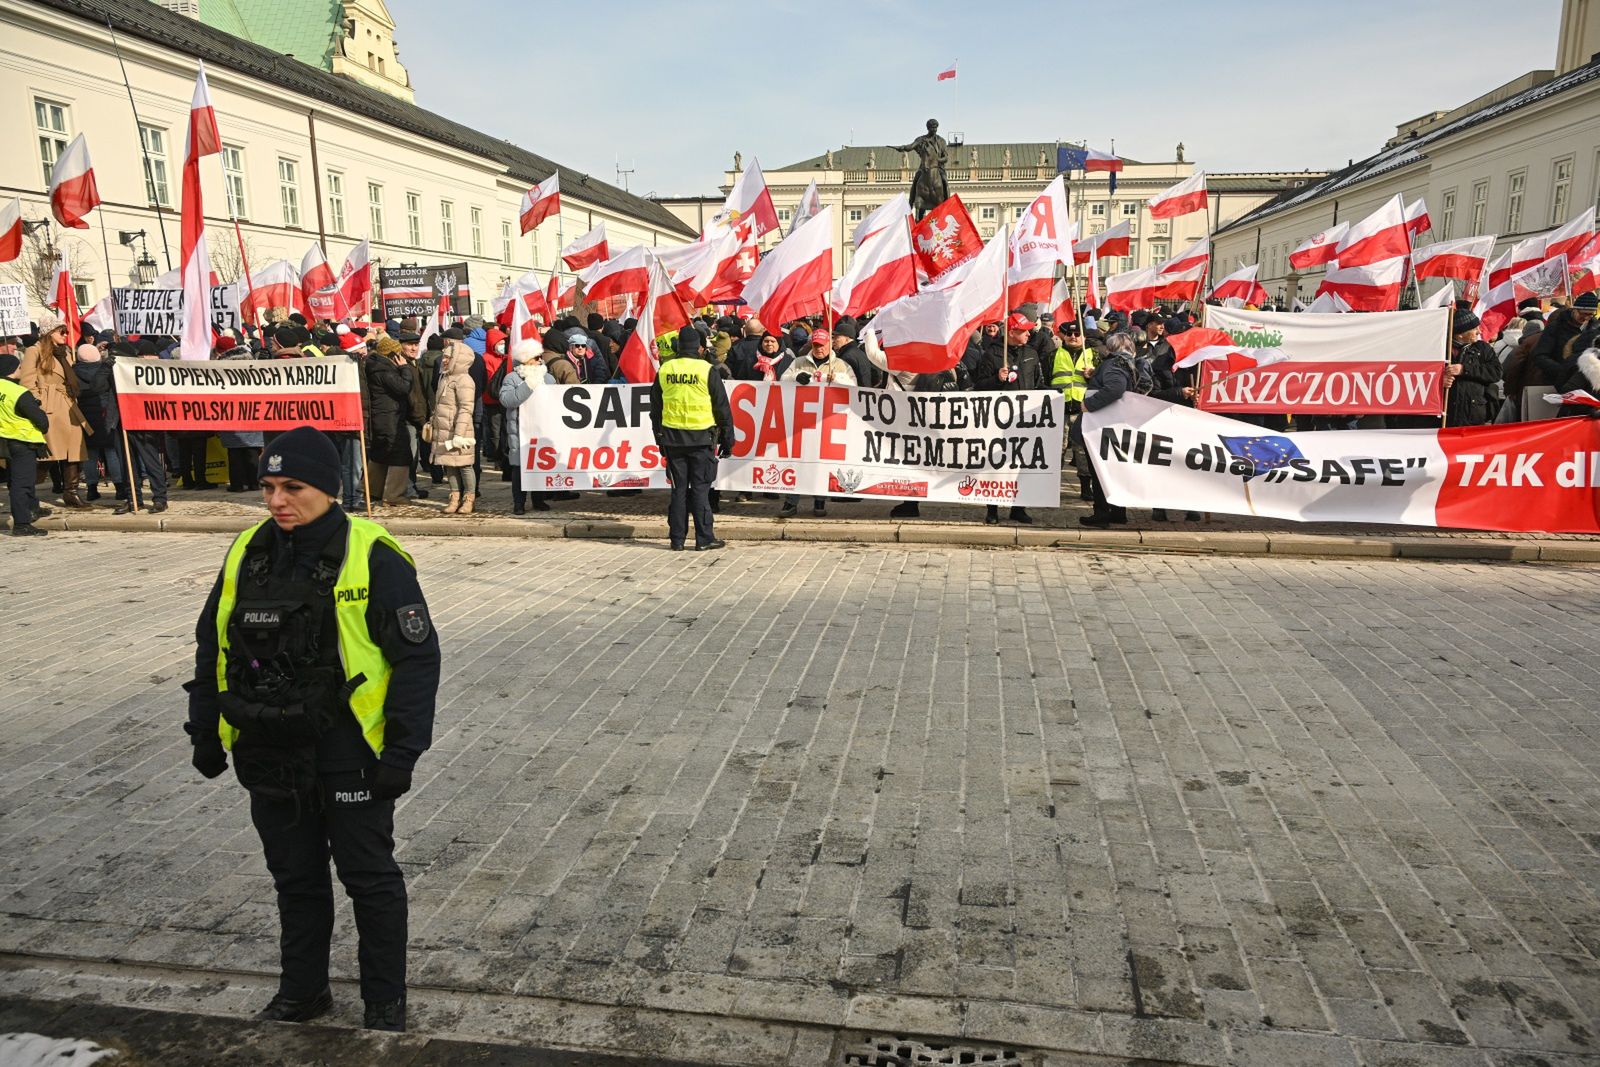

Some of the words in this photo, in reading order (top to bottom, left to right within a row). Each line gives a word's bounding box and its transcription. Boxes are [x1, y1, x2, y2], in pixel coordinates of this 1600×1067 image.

[113, 289, 131, 310] NIE
[145, 312, 175, 334] NAM
[135, 366, 165, 385] POD
[171, 366, 226, 389] OPIEKĄ
[226, 365, 281, 386] DWÓCH
[283, 364, 336, 385] KAROLI
[666, 373, 698, 385] POLICJA
[1207, 364, 1437, 406] KRZCZONÓW
[144, 400, 177, 421] NIKT
[183, 400, 234, 421] POLSKI
[237, 400, 261, 420] NIE
[264, 400, 335, 420] ZNIEWOLI
[561, 386, 651, 430] SAF
[858, 390, 896, 425] TO
[908, 394, 1057, 430] NIEWOLA
[730, 383, 850, 461] SAFE
[526, 438, 557, 471] is
[567, 440, 632, 470] not
[862, 430, 1049, 470] NIEMIECKA
[1100, 427, 1174, 464] NIE
[1184, 443, 1254, 477] dla
[1455, 452, 1544, 487] TAK
[975, 489, 1018, 498] POLACY
[980, 480, 1018, 489] WOLNI
[337, 588, 369, 602] POLIC
[244, 612, 280, 623] POLICJA
[336, 790, 371, 802] POLICJ
